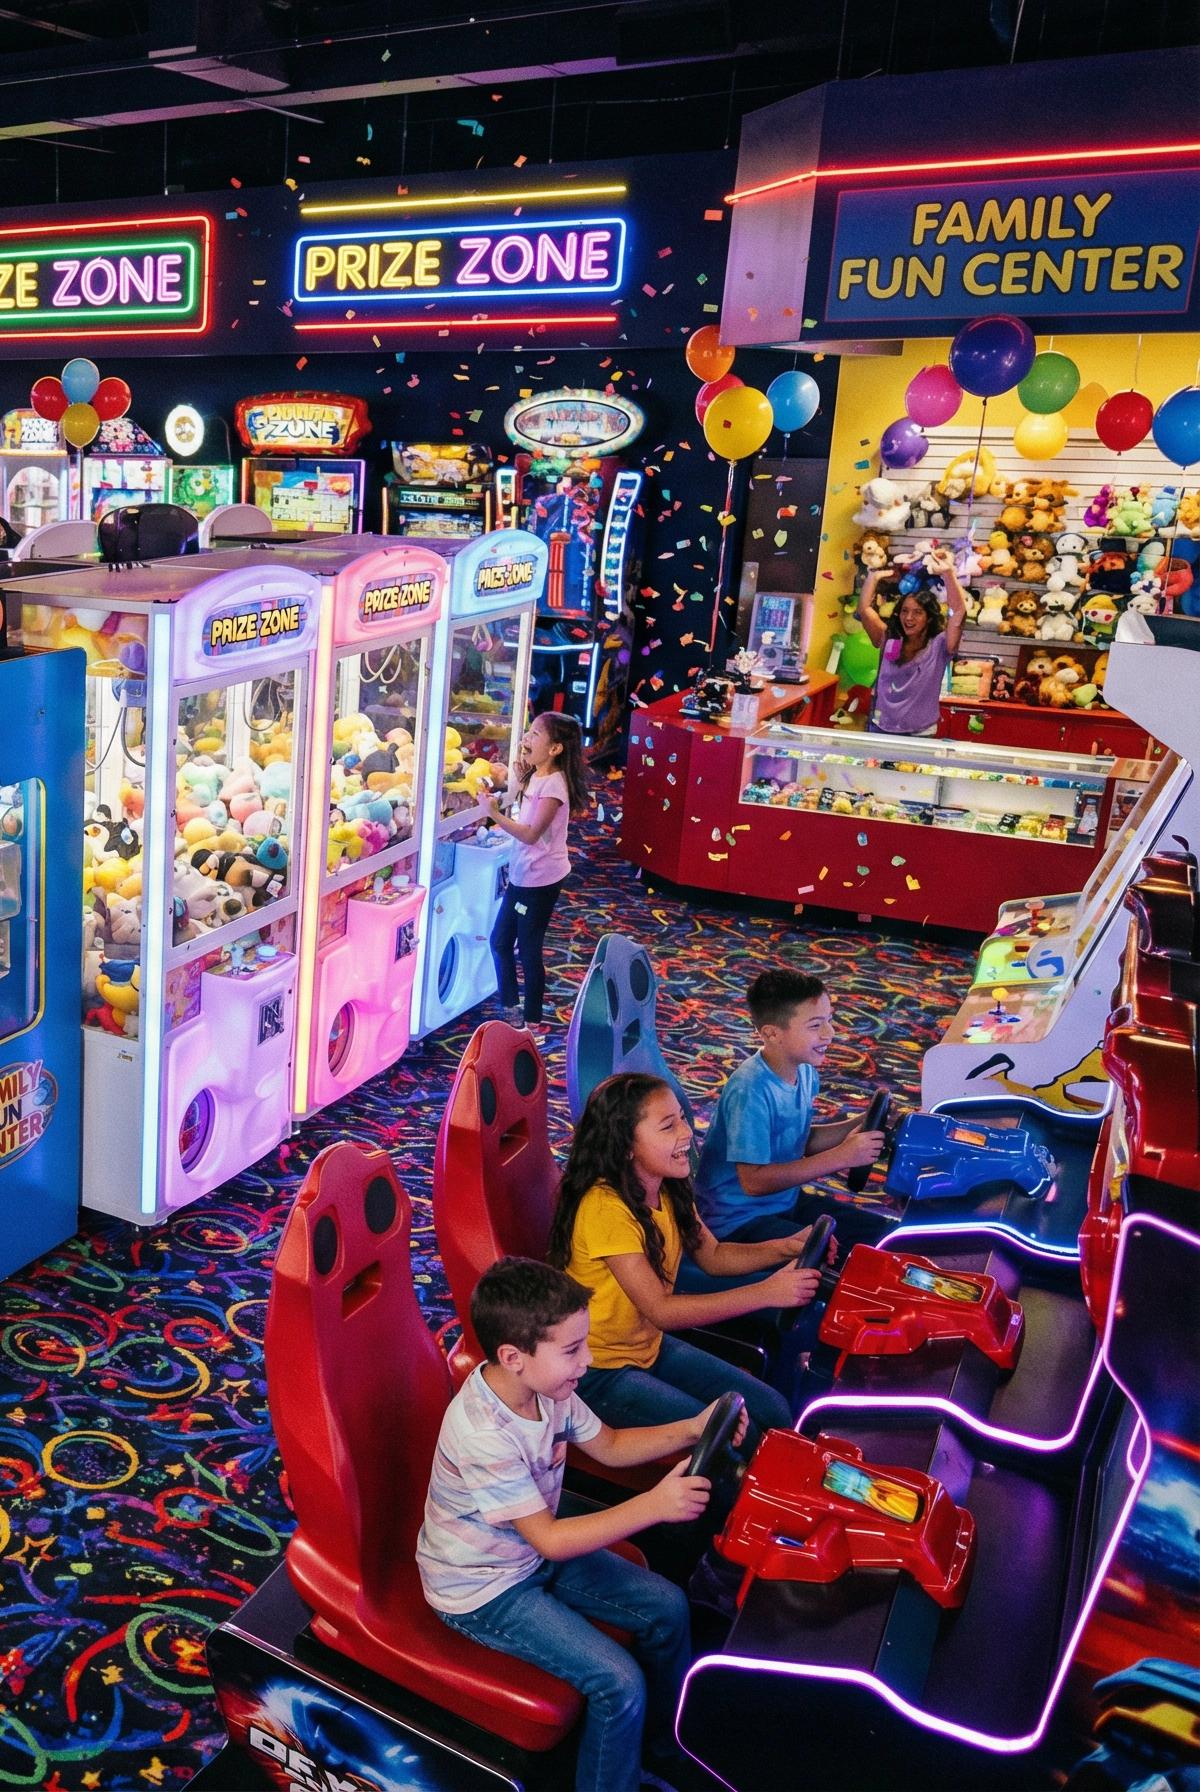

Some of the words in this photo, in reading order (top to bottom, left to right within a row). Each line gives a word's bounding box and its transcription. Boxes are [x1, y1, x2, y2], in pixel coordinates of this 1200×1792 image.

[912, 192, 1113, 246] FAMILY
[51, 254, 183, 307] ZONE
[305, 240, 442, 292] PRIZE
[456, 231, 611, 285] ZONE
[838, 254, 946, 301] FUN
[962, 244, 1185, 297] CENTER
[363, 586, 400, 616] PRIZE
[399, 579, 433, 608] ZONE
[210, 613, 258, 647] PRIZE
[259, 604, 301, 639] ZONE
